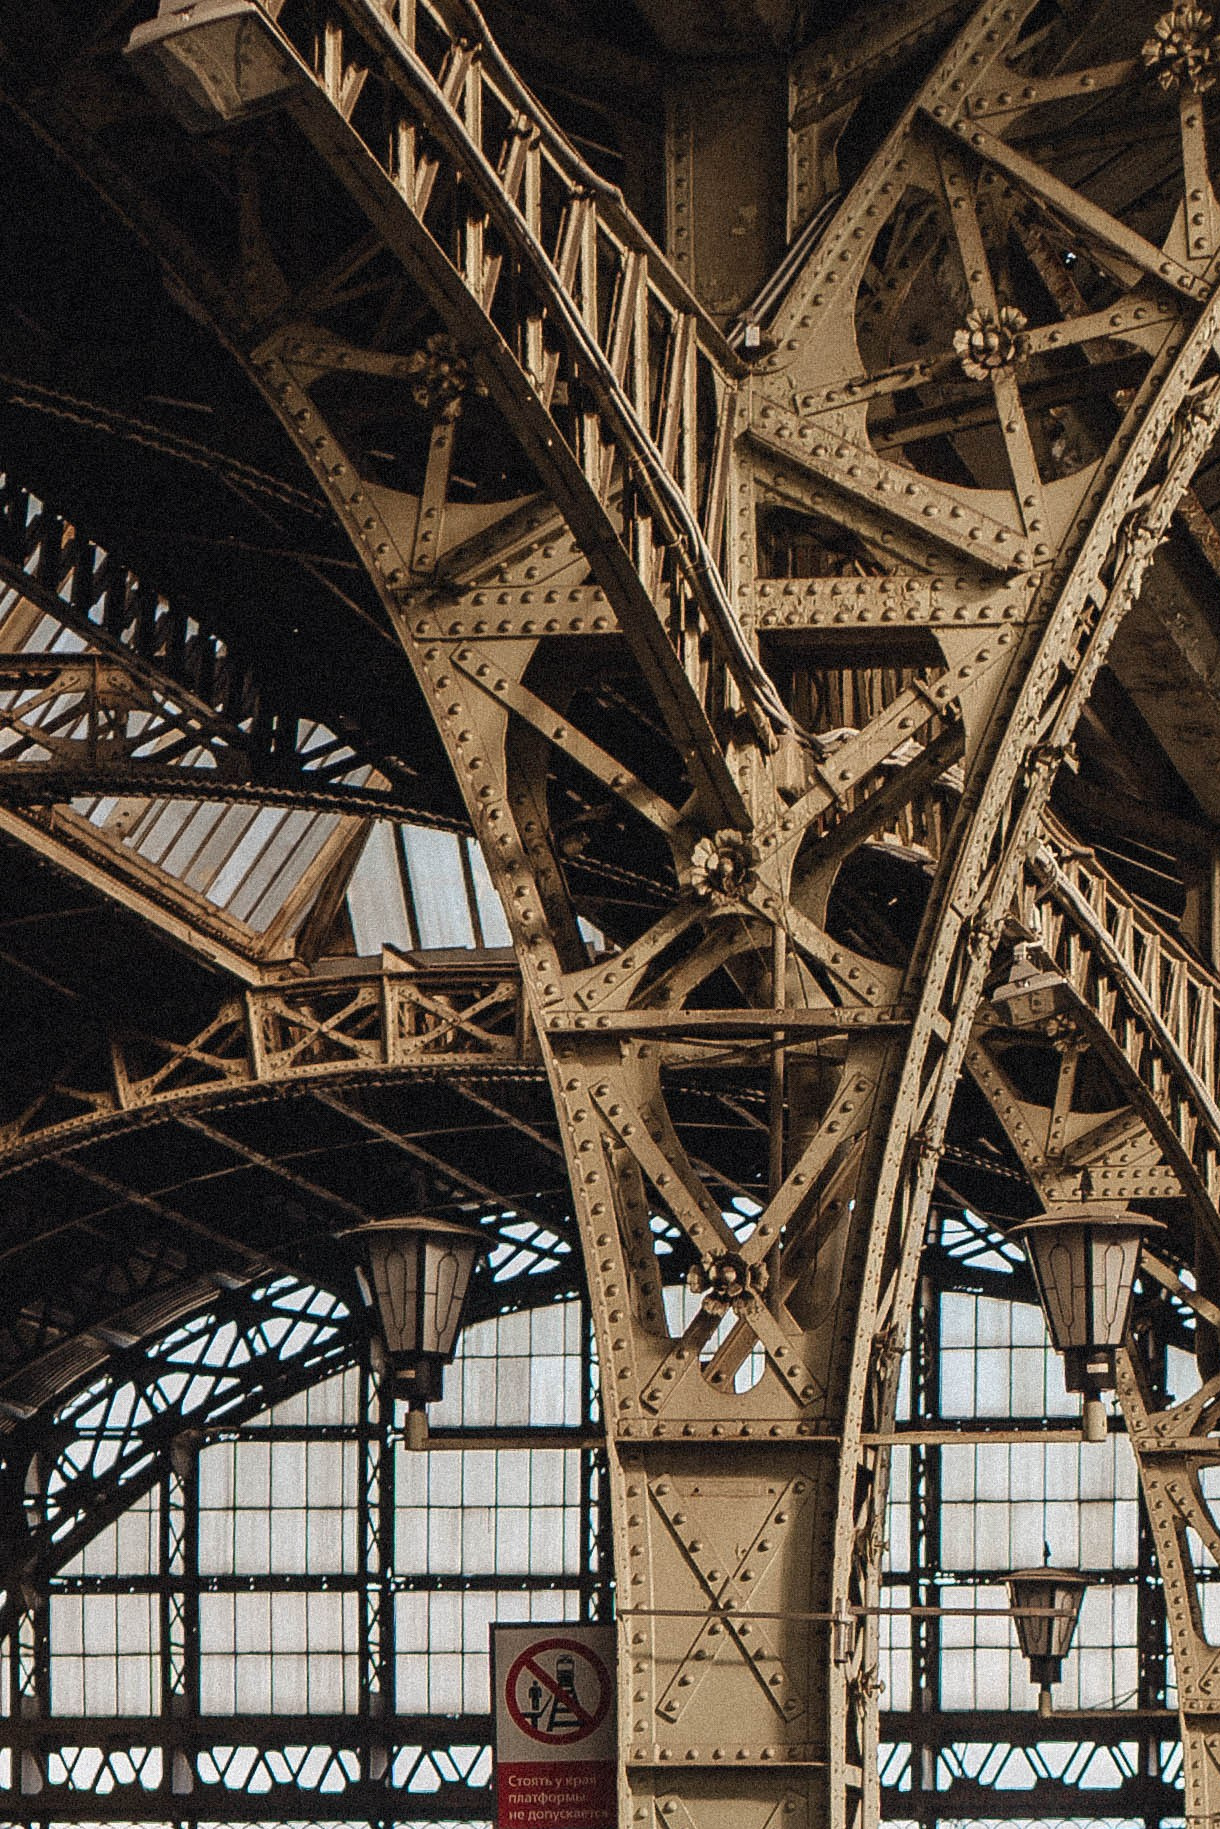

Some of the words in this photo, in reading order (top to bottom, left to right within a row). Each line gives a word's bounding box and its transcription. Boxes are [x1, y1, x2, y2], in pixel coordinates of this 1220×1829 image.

[508, 1775, 553, 1787] Стоять
[556, 1777, 563, 1788] у
[566, 1777, 597, 1788] края
[508, 1792, 586, 1805] платформы
[508, 1810, 525, 1820] не
[528, 1809, 608, 1821] допускается
